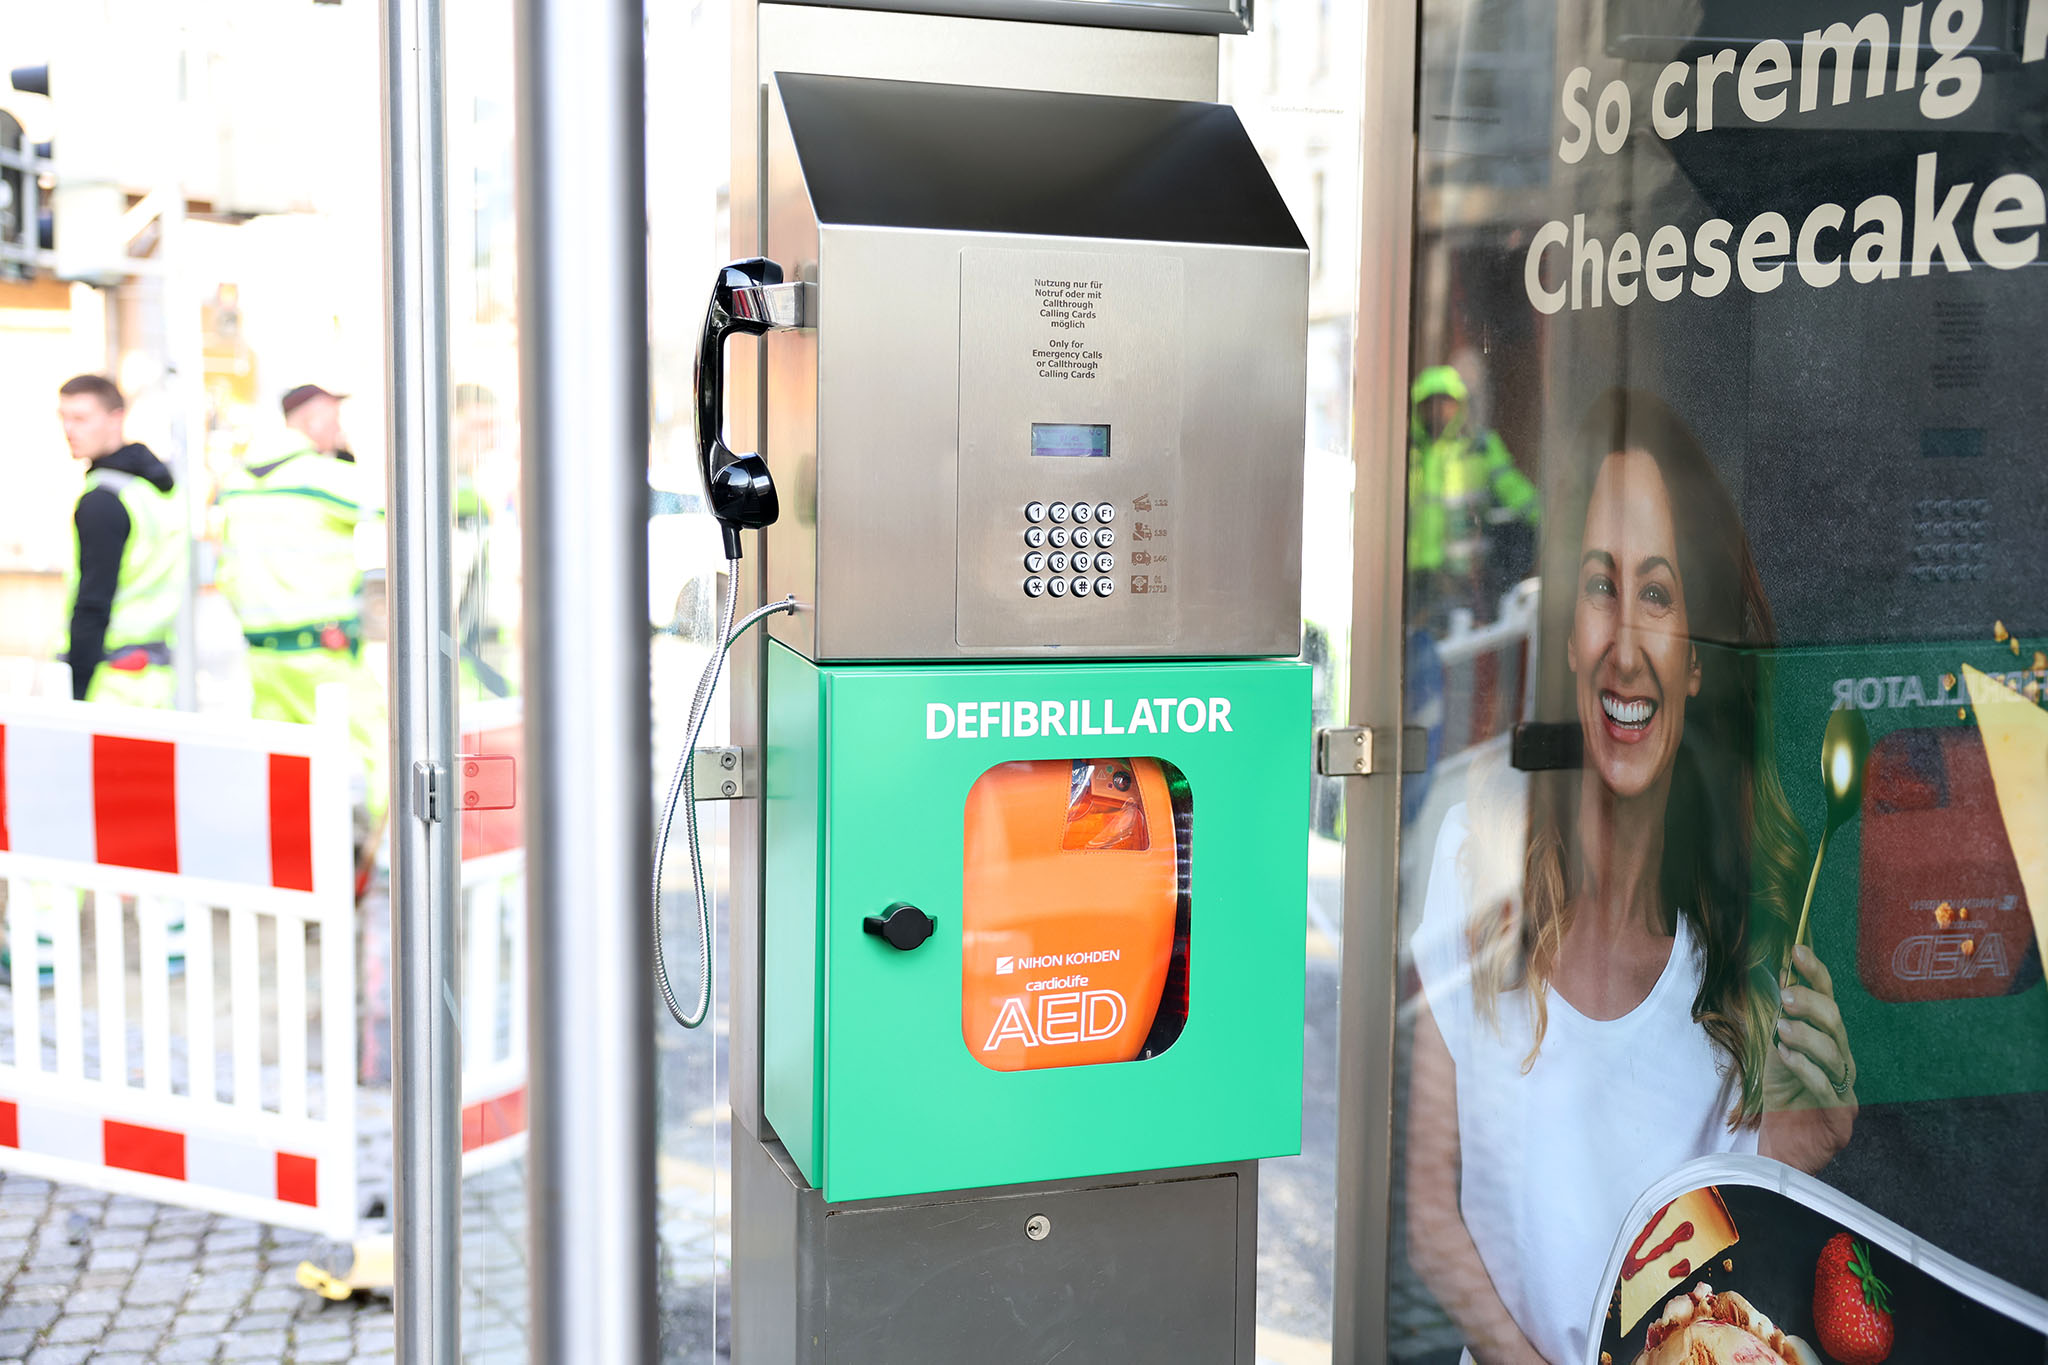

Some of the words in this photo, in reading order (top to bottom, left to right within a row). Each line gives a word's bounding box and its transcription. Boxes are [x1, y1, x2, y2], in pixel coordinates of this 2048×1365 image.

[1558, 66, 1632, 164] So
[1652, 0, 1984, 141] cremig
[1524, 151, 2046, 315] Cheesecake
[1034, 279, 1071, 289] Nutzung
[1073, 281, 1088, 289] nur
[1090, 280, 1103, 289] für
[1035, 289, 1064, 297] Notruf
[1065, 290, 1085, 298] oder
[1087, 291, 1102, 299] mit
[1043, 299, 1094, 310] Callthrough
[1040, 309, 1070, 319] Calling
[1072, 310, 1097, 319] Cards
[1051, 320, 1085, 330] möglich
[1049, 339, 1069, 349] Only
[1071, 340, 1084, 349] for
[1032, 349, 1080, 360] Emergency
[1082, 350, 1103, 359] Calls
[1048, 360, 1098, 370] Callthrough
[1039, 369, 1069, 379] Calling
[1071, 370, 1096, 379] Cards
[1034, 507, 1040, 519] 1
[1057, 507, 1065, 519] 2
[1080, 507, 1088, 520] 3
[1101, 509, 1112, 518] F1
[1033, 532, 1041, 544] 4
[1057, 532, 1065, 543] 5
[1080, 531, 1088, 543] 6
[1101, 533, 1113, 542] F2
[1034, 557, 1042, 568] 7
[1056, 557, 1065, 569] 8
[1079, 556, 1088, 568] 9
[1101, 558, 1112, 567] F3
[1056, 581, 1065, 593] 0
[1101, 583, 1112, 591] F4
[926, 697, 1234, 740] DEFIBRILLATOR
[1018, 954, 1063, 970] NIHON
[1066, 949, 1120, 966] KOHDEN
[1025, 974, 1089, 992] cardiolife
[983, 989, 1127, 1051] AED
